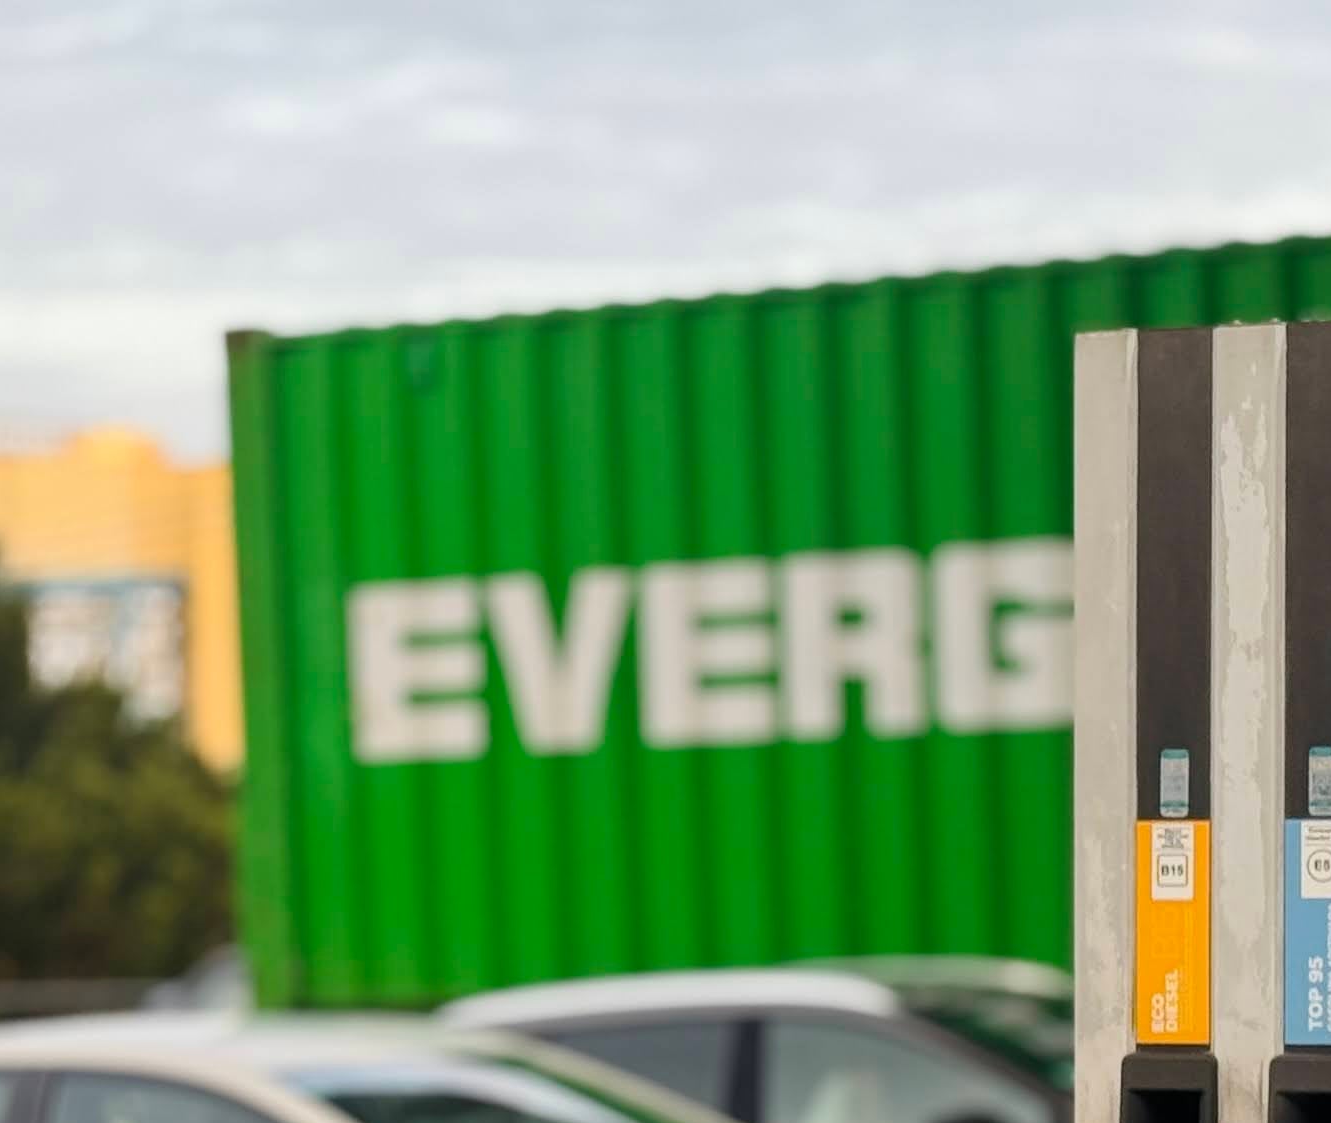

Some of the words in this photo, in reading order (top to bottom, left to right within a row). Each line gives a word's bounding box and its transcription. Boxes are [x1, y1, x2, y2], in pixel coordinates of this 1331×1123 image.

[345, 536, 1074, 766] EVERG
[1162, 864, 1184, 876] B15
[1308, 956, 1324, 983] 95
[1151, 993, 1165, 1033] ECO
[1165, 969, 1178, 1033] DIESEL
[1308, 990, 1323, 1032] TOP
